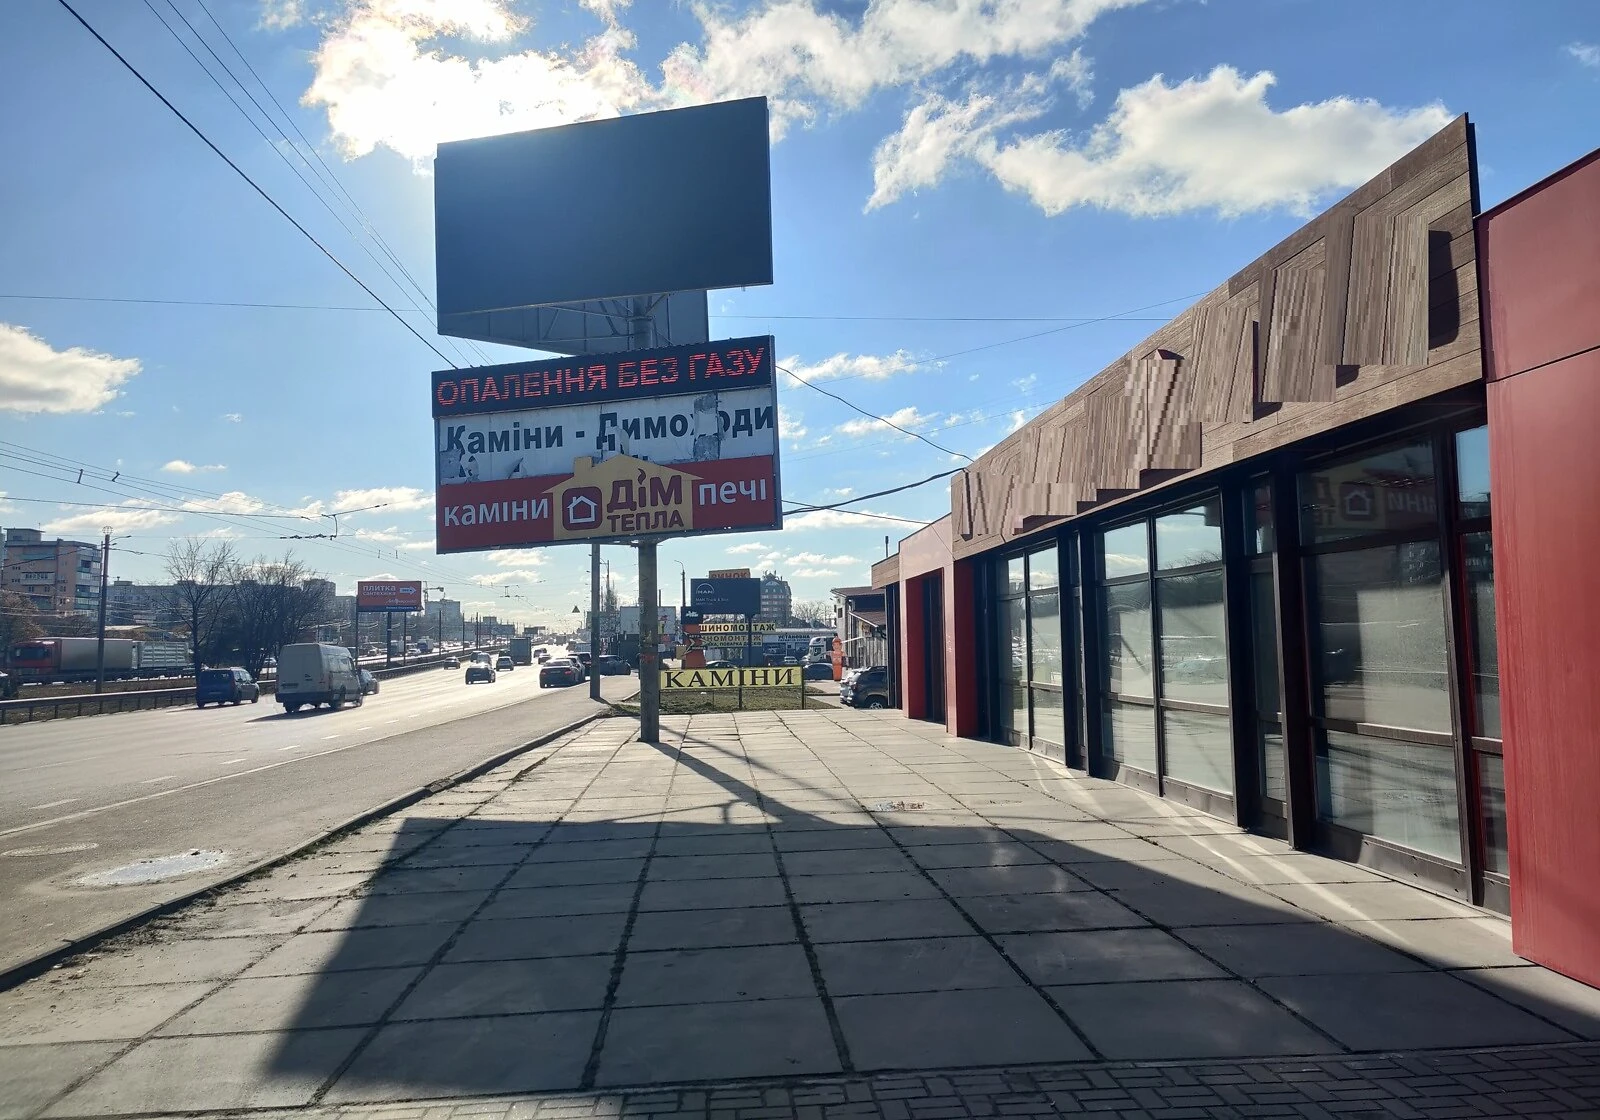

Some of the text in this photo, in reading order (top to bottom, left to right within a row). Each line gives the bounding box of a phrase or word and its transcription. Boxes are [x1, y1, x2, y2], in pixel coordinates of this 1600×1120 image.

[436, 347, 765, 406] ОПАЛЕННЯ БЕЗ ГАЗУ
[446, 421, 563, 455] Каміни
[596, 405, 774, 452] Димооди
[699, 479, 767, 507] печі
[443, 497, 549, 527] каміни
[606, 510, 684, 532] ТЕПЛА
[664, 668, 794, 688] КАМІНИ
